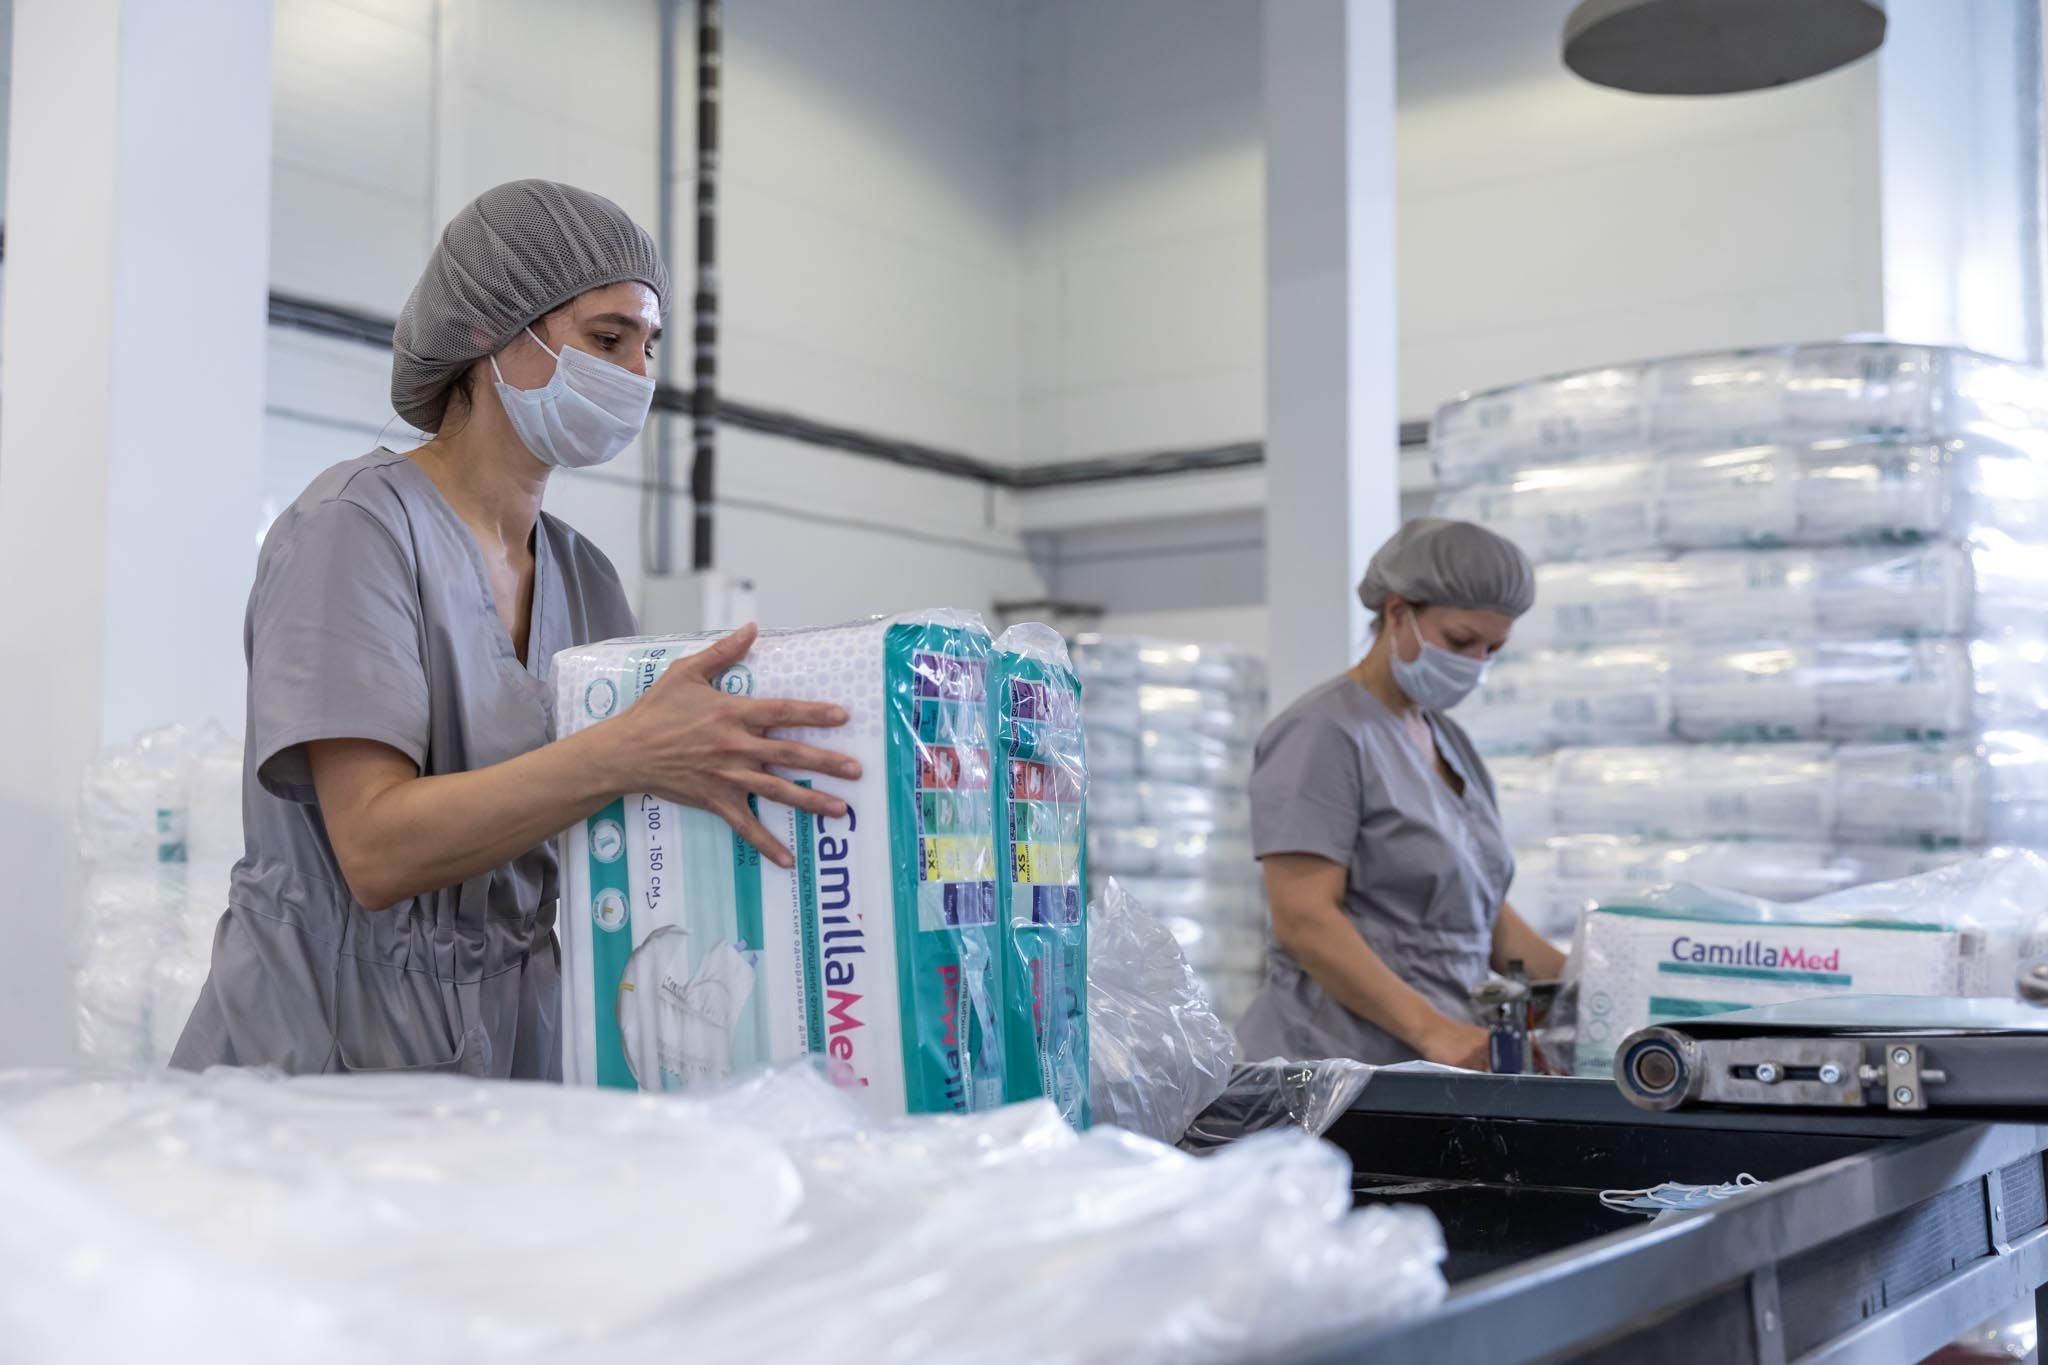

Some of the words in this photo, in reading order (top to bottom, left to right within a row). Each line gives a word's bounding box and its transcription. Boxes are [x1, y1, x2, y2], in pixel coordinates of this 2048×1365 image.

[648, 805, 662, 831] 100
[650, 845, 664, 871] 150
[928, 850, 936, 870] XS
[1017, 853, 1026, 873] XS
[801, 857, 813, 906] СРЕДСТВА
[805, 909, 814, 929] ПРИ
[806, 931, 817, 993] НАРУШЕНИИ
[1671, 936, 1840, 972] CamillaMed
[793, 940, 805, 1021] одноразовые
[810, 995, 822, 1044] ФУНКЦИЙ
[798, 1024, 807, 1047] для
[936, 963, 967, 1112] illaMed
